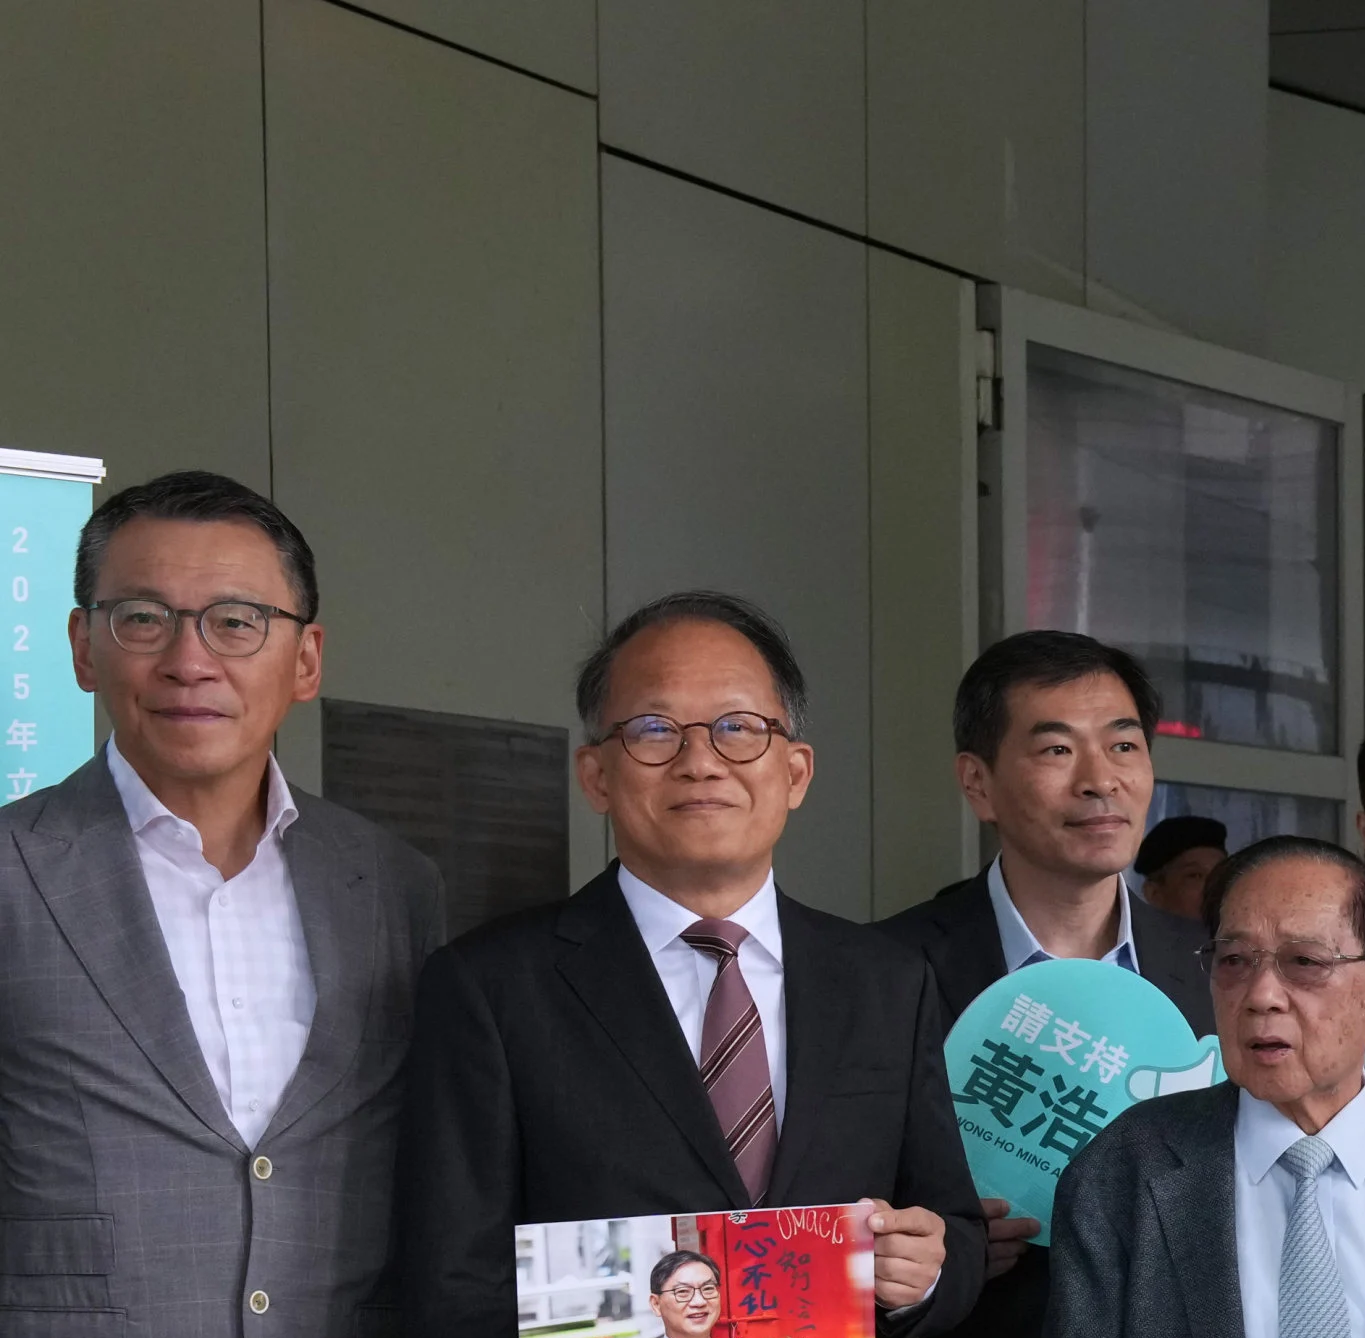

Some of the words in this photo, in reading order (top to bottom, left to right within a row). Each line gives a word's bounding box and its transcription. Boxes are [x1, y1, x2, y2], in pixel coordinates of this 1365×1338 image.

[1000, 993, 1130, 1084] 請支持
[994, 1136, 1015, 1153] HO
[1016, 1148, 1051, 1172] MING
